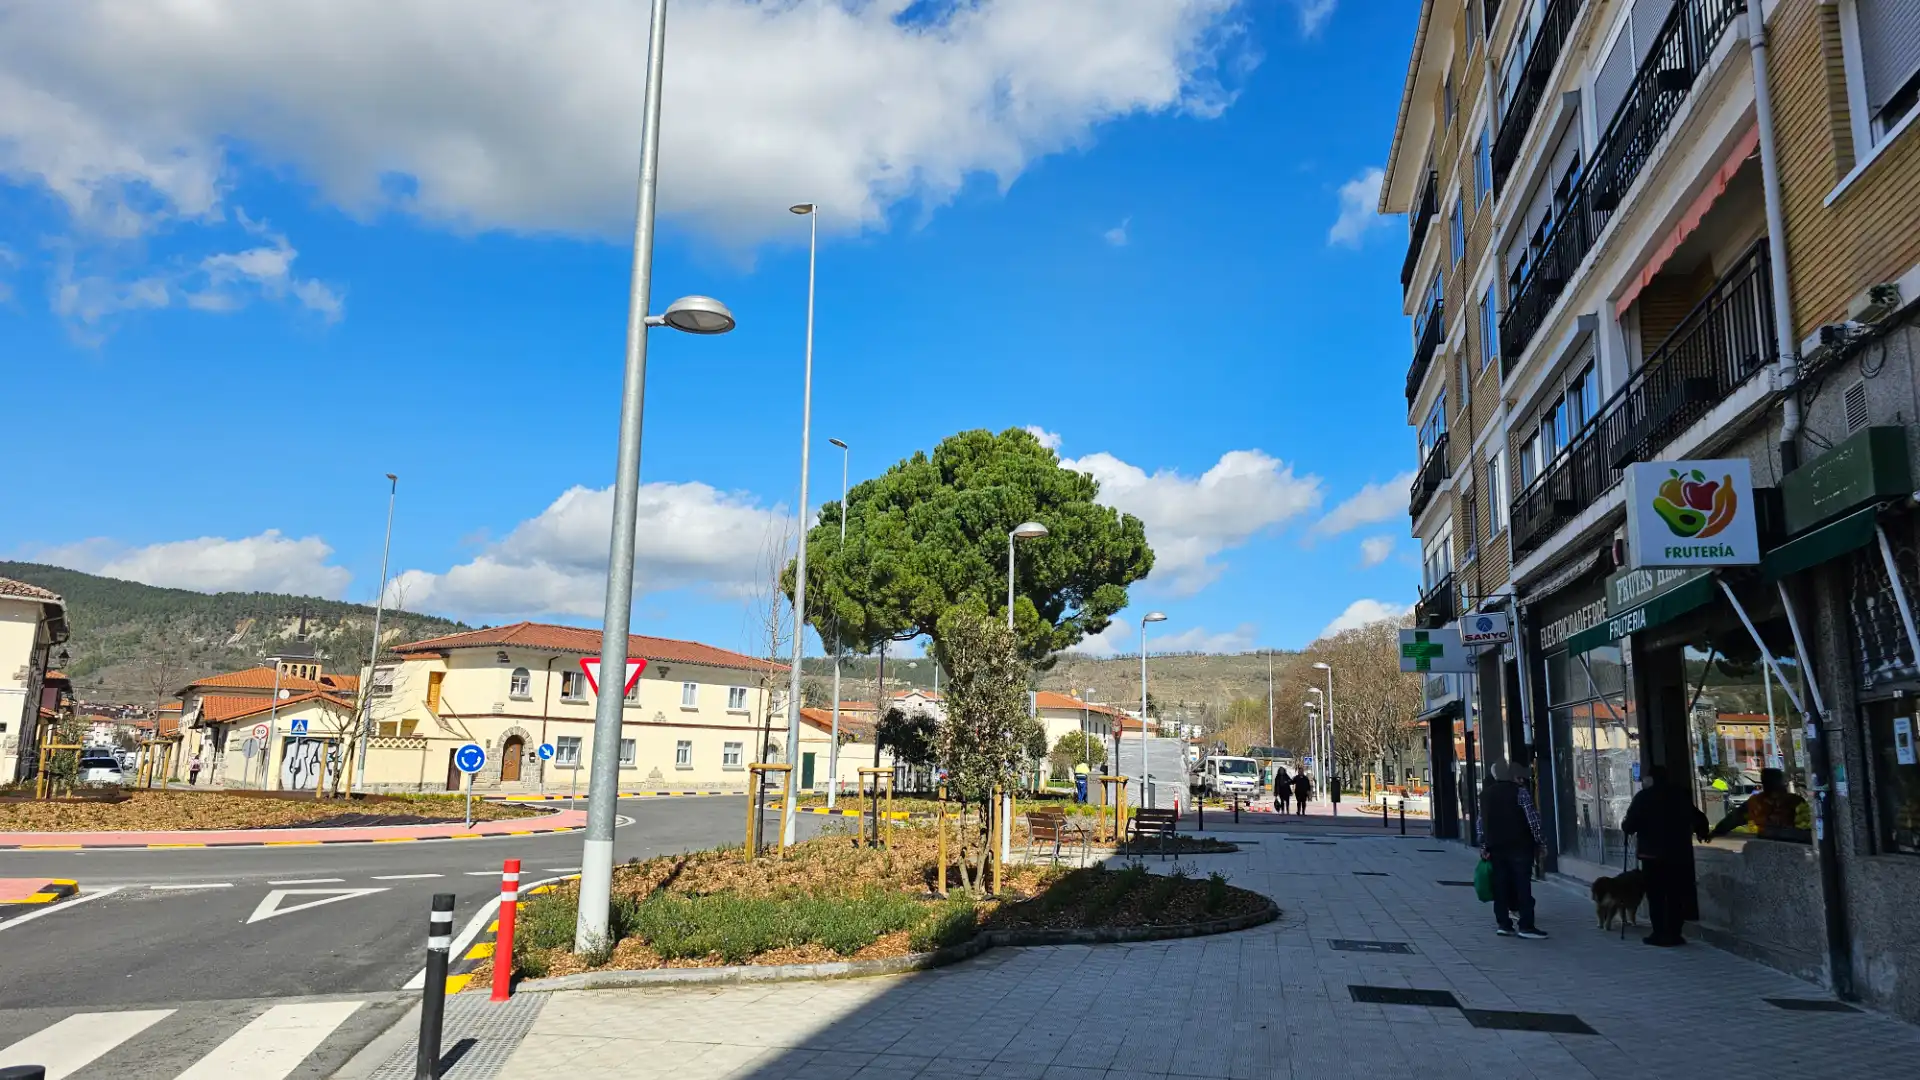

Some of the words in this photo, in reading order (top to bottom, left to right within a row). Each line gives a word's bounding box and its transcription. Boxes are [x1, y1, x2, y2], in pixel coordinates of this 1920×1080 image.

[1664, 543, 1735, 559] FRUTERÍA
[1616, 569, 1653, 605] FRUTAS
[1464, 631, 1508, 641] SANYO
[1609, 608, 1646, 640] FRUTERIA
